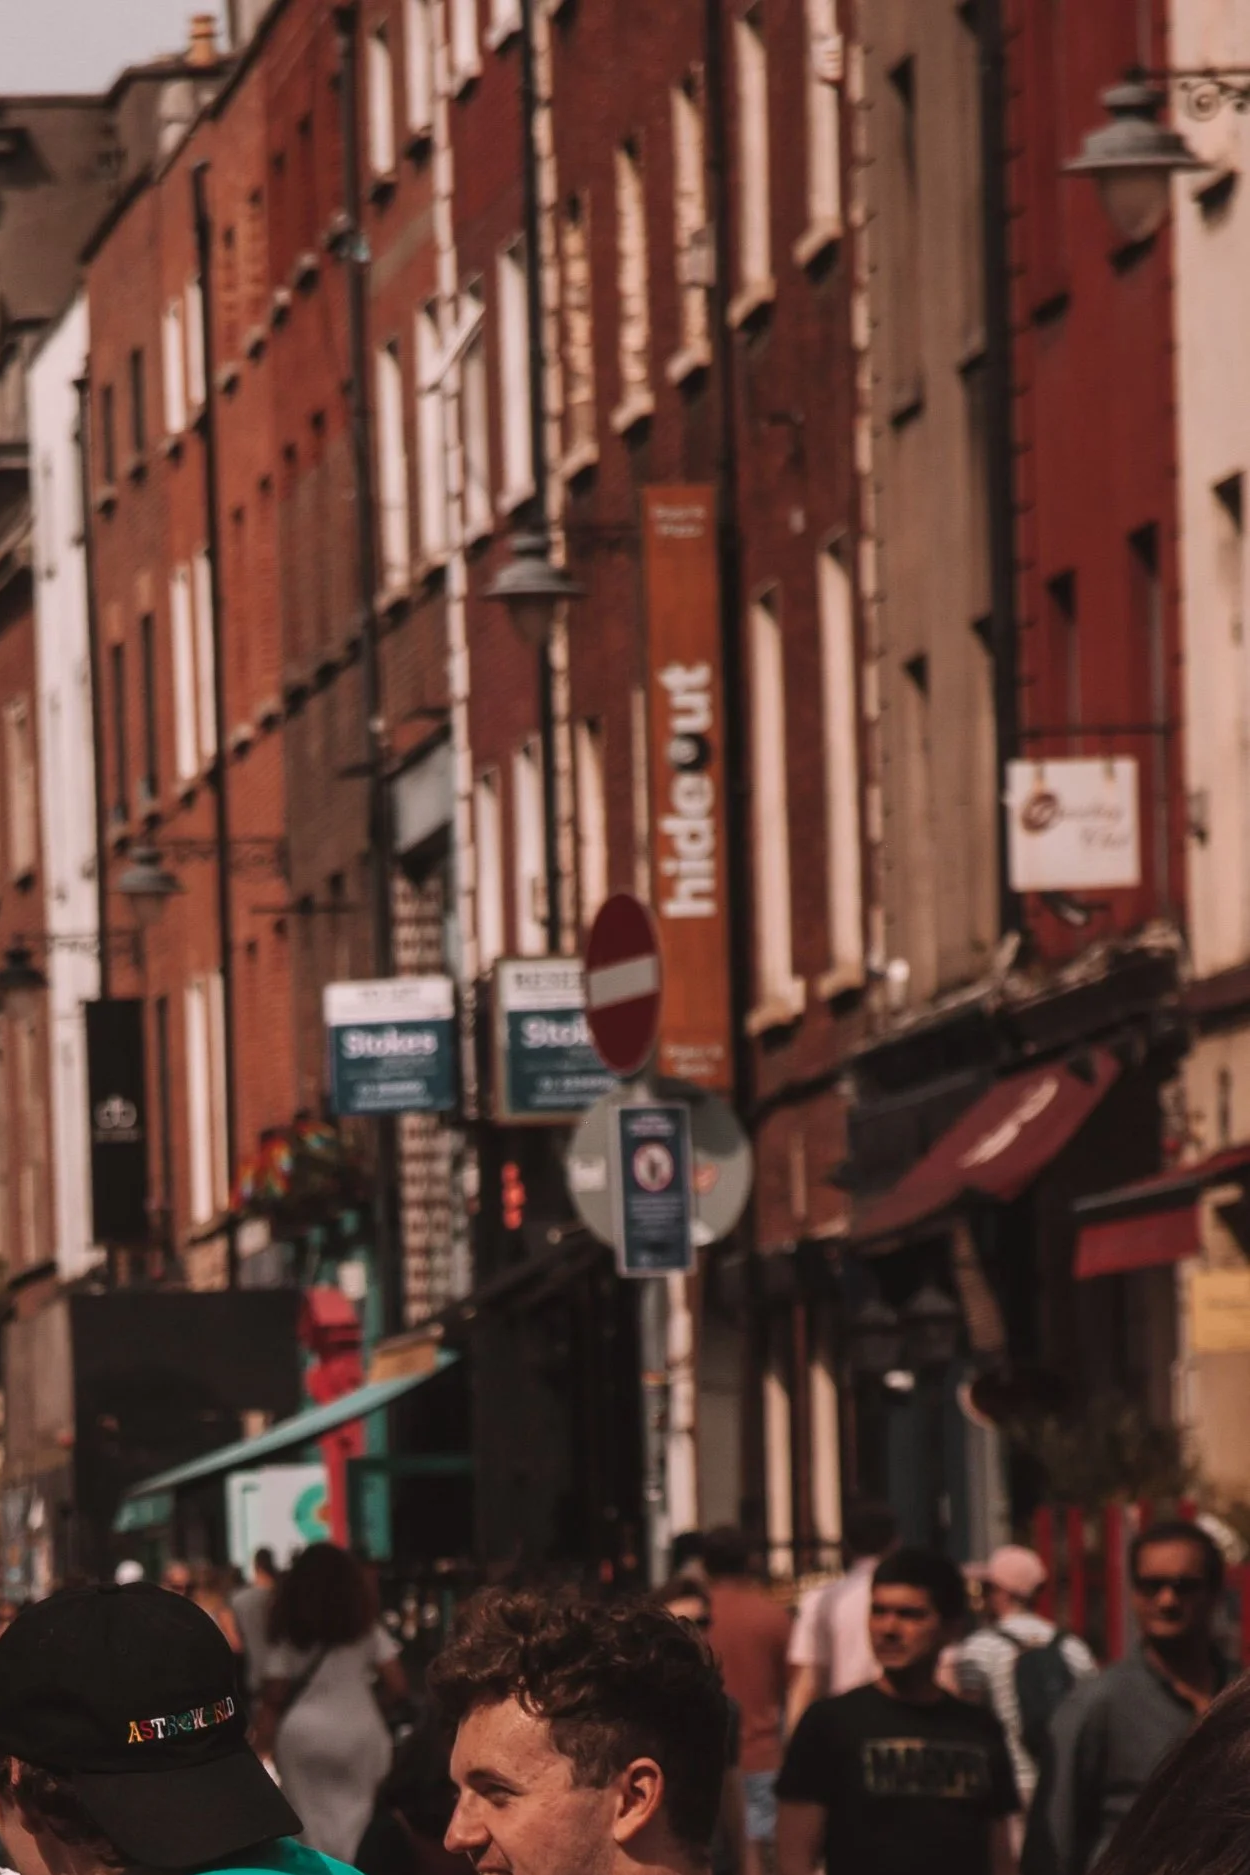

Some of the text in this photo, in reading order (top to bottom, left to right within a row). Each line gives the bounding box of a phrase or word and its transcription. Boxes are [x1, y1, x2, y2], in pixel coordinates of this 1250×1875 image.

[657, 661, 716, 917] hideout
[342, 1027, 438, 1059] Stokes
[127, 1696, 235, 1744] ASTROWORLD
